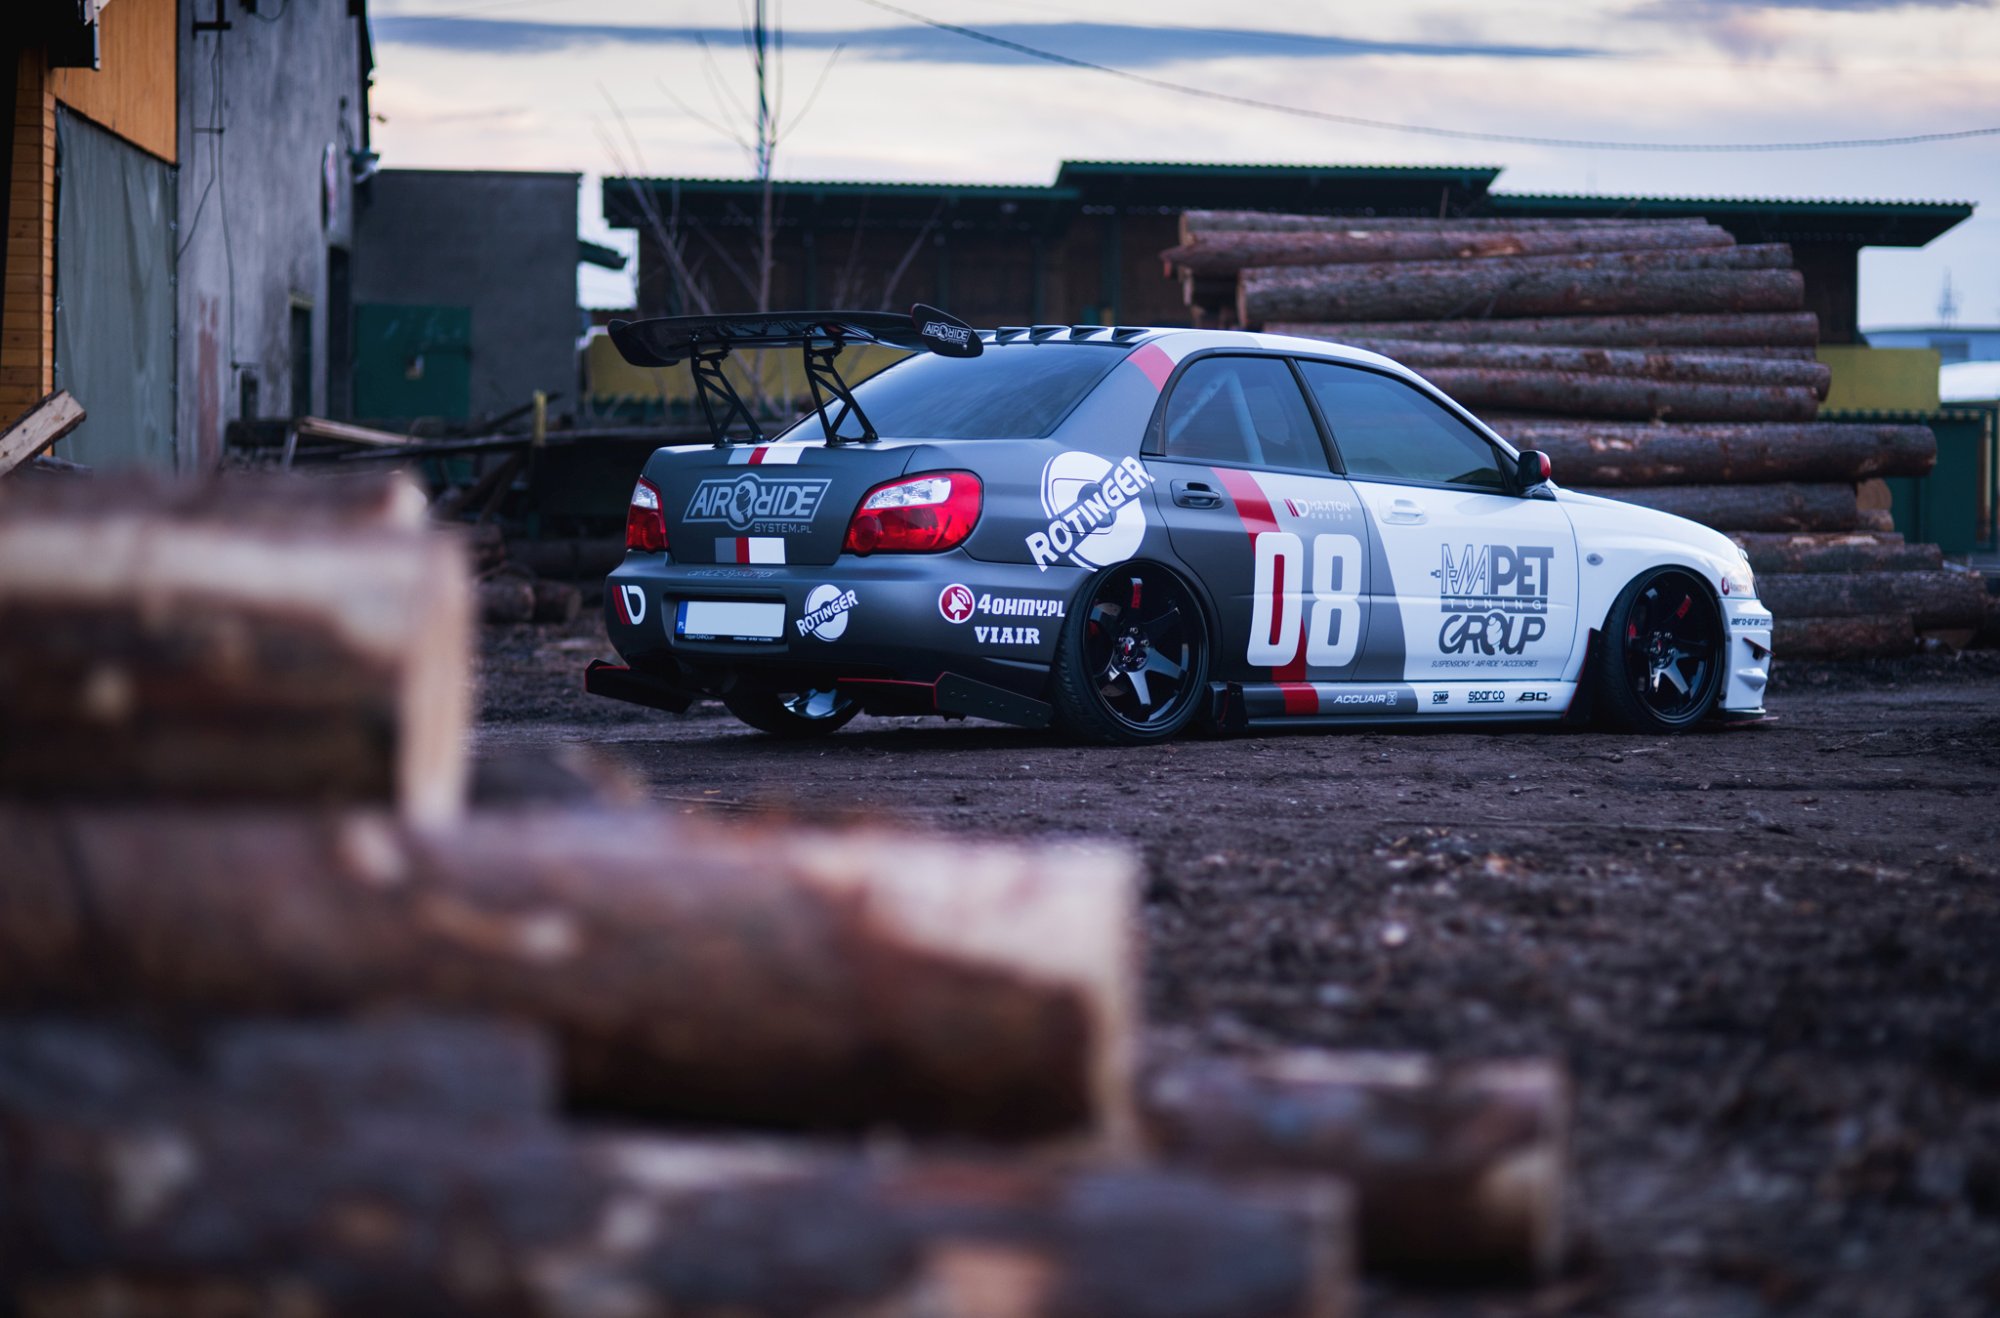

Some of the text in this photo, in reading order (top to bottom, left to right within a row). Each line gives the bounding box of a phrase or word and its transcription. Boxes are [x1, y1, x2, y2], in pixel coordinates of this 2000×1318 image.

[1310, 500, 1351, 512] MAXTON
[1025, 456, 1156, 572] ROTINGER
[1310, 512, 1352, 521] design
[754, 523, 812, 534] SYSTEM.PL
[1440, 543, 1554, 596] MAPET
[977, 593, 1065, 618] 4OHMY.PL
[1247, 532, 1362, 667] 08
[1448, 598, 1542, 610] TUNING
[796, 589, 859, 637] ROTINGER
[974, 626, 1040, 644] VIAIR
[1438, 612, 1546, 656] GROUP
[1431, 660, 1470, 668] SUSPENSIONS
[1334, 694, 1386, 704] ACCUAIR
[1432, 693, 1449, 703] OMP
[1468, 690, 1505, 702] sparco
